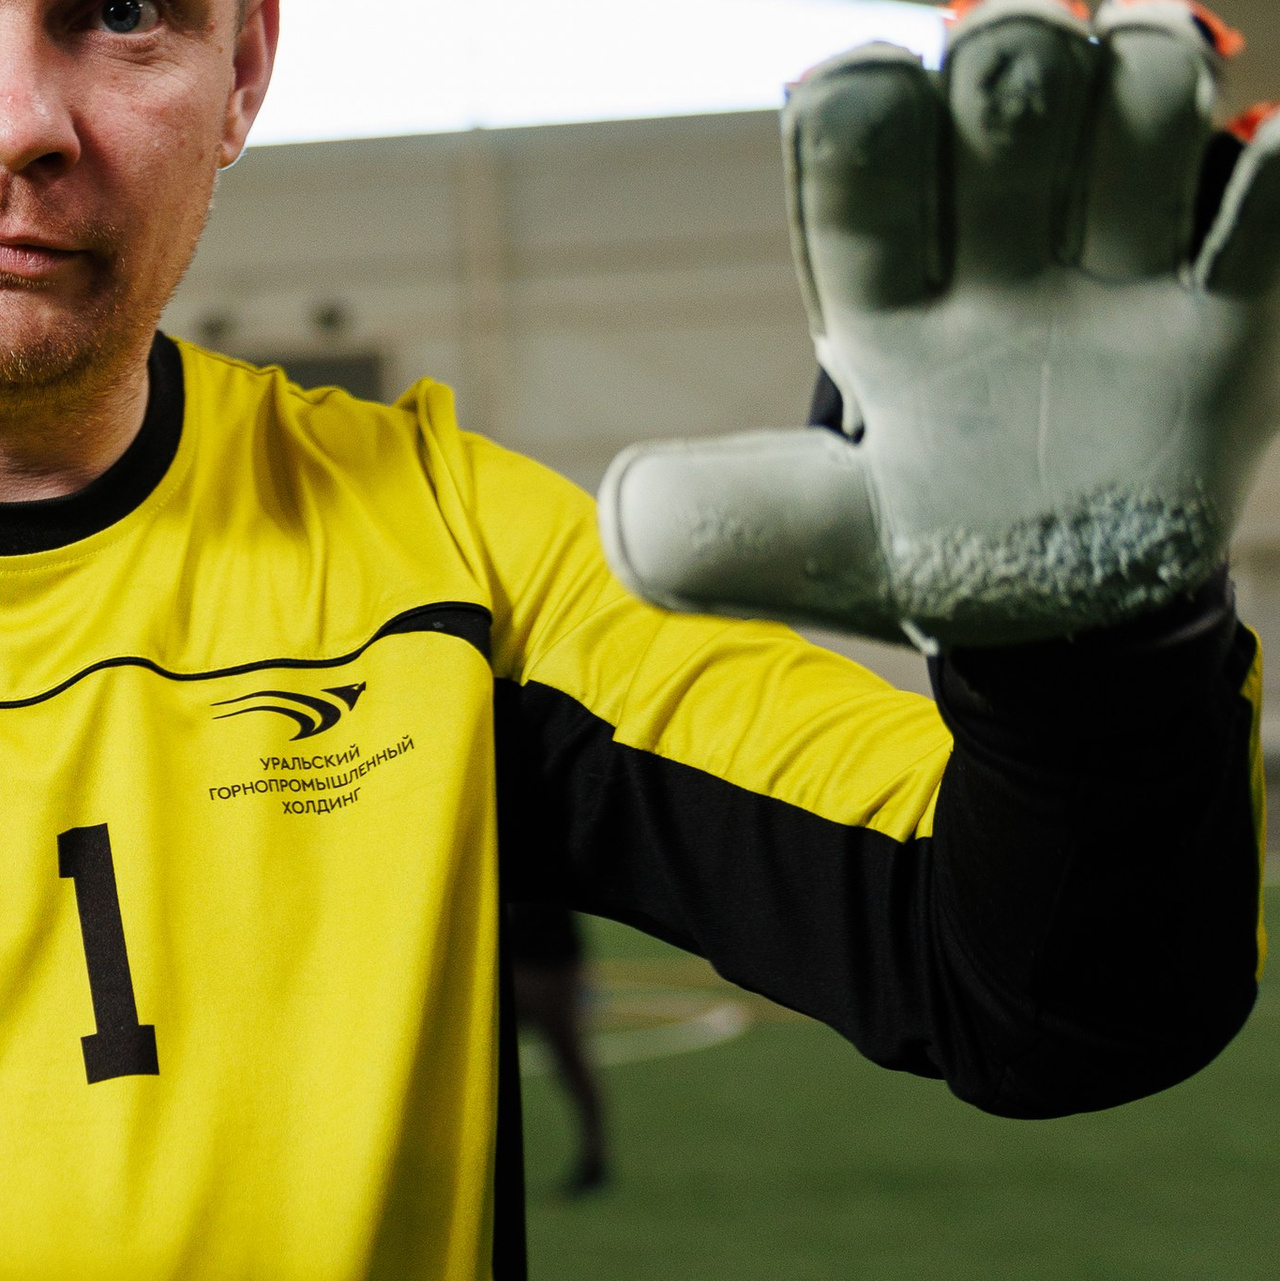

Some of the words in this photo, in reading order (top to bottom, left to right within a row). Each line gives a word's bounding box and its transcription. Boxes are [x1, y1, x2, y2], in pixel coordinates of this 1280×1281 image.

[209, 735, 415, 801] ГОРНОПРОМЫШЛЕННЫЙ
[260, 744, 361, 771] УРАЛЬСКИЙ
[282, 787, 362, 815] ХОЛДИНГ
[56, 822, 160, 1085] 1
